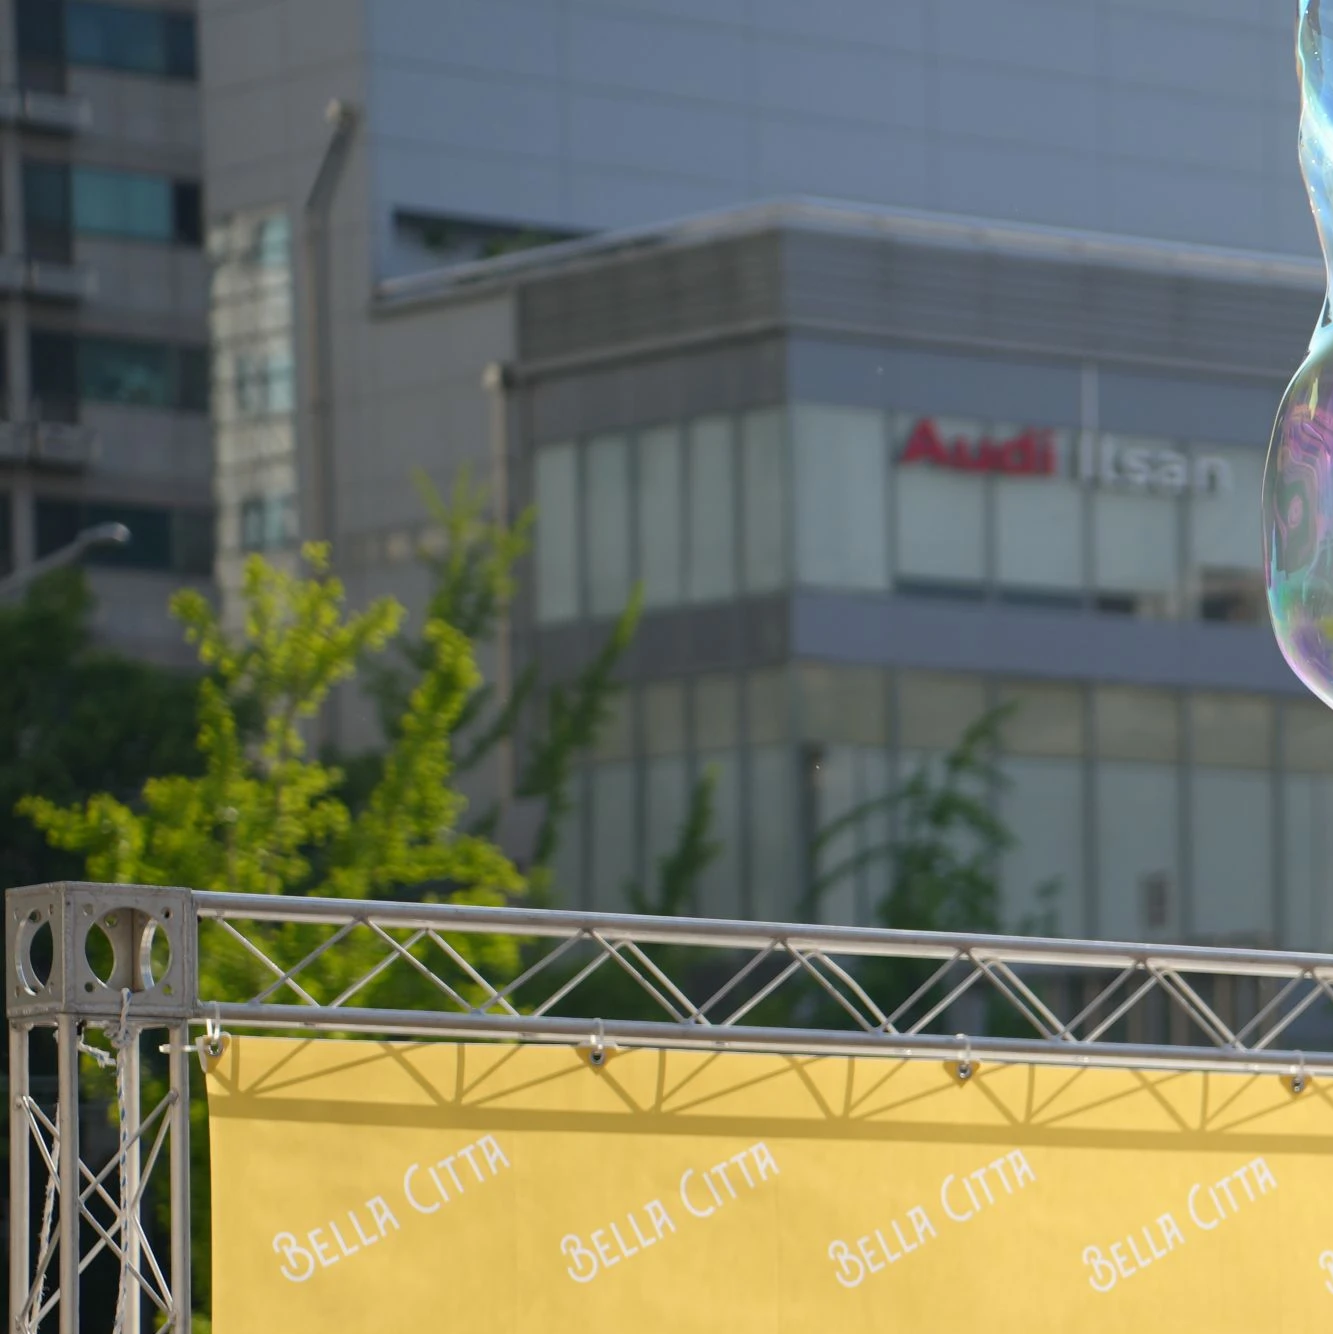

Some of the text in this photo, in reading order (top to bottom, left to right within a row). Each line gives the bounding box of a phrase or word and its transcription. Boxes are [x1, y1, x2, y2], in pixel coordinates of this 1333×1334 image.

[899, 417, 1059, 477] Audi
[272, 1134, 511, 1283] BELLA CITTA
[560, 1141, 782, 1284] BELLA CITTA
[828, 1148, 1037, 1288] BELLA CITTA
[1081, 1156, 1279, 1292] BELLA CITTA
